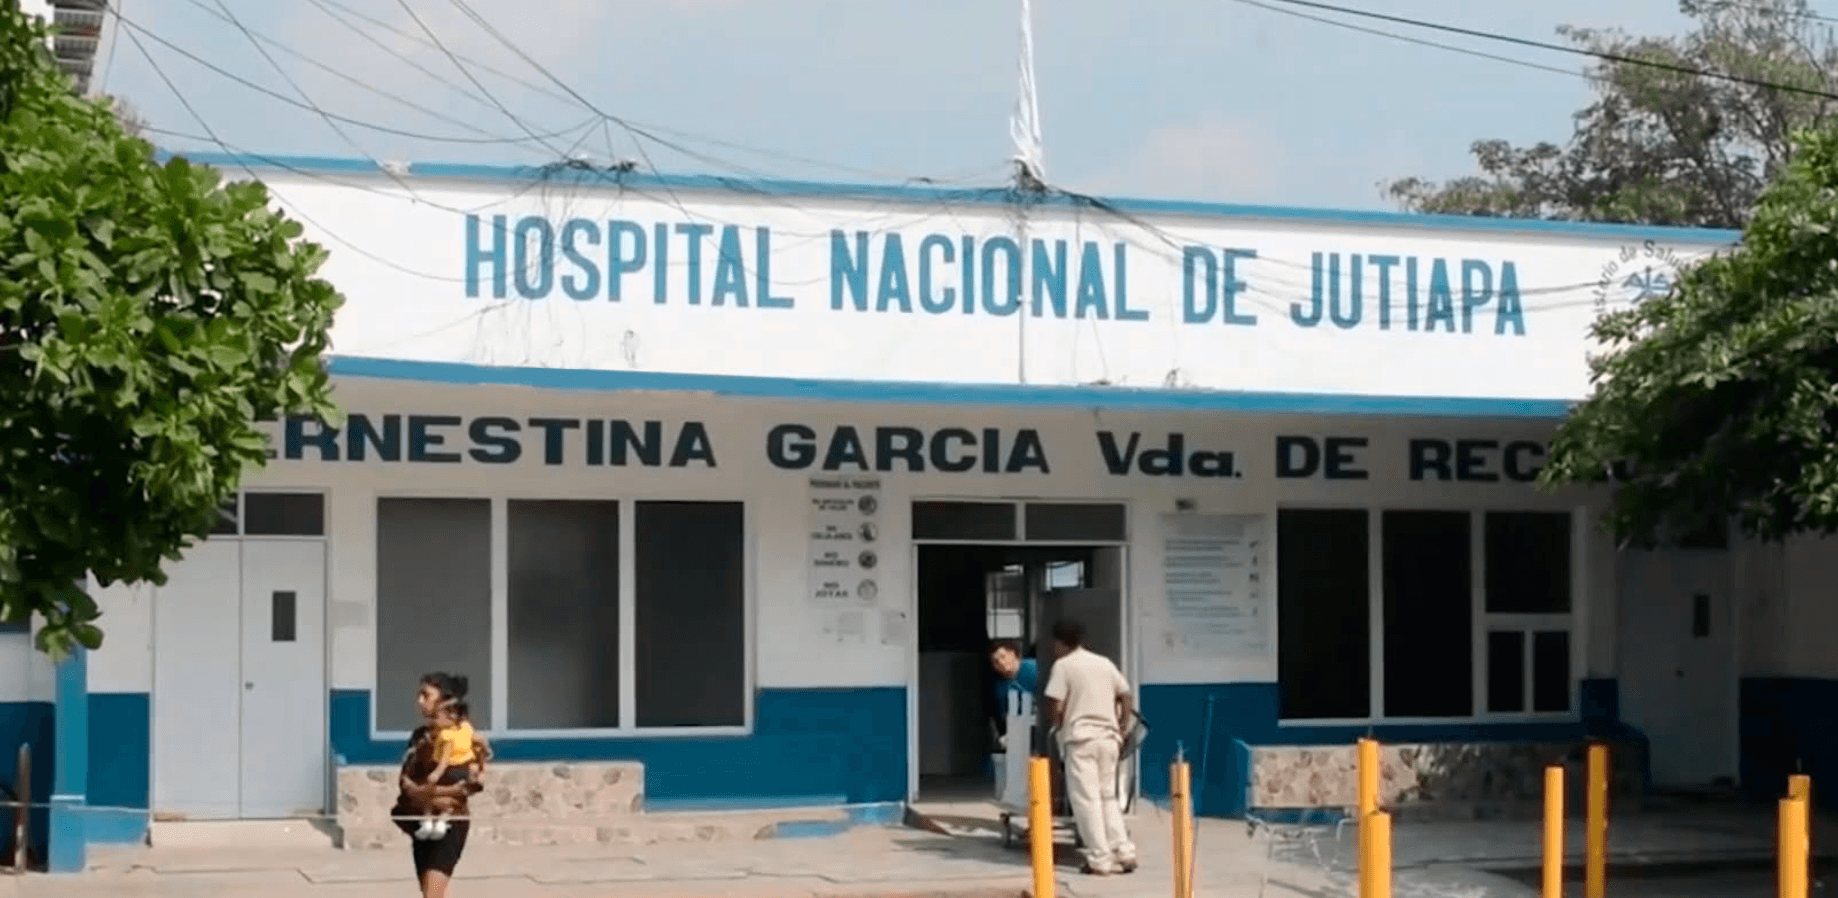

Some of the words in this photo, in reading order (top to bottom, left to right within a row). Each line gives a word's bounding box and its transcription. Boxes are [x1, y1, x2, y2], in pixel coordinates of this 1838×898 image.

[465, 213, 795, 309] HOSPITAL
[830, 229, 1149, 321] NACIONAL
[1182, 244, 1258, 327] DE
[1290, 251, 1526, 337] JUTIAPA
[766, 423, 1051, 475] GARCIA
[1096, 430, 1243, 479] Vda.
[1276, 435, 1369, 480] DE
